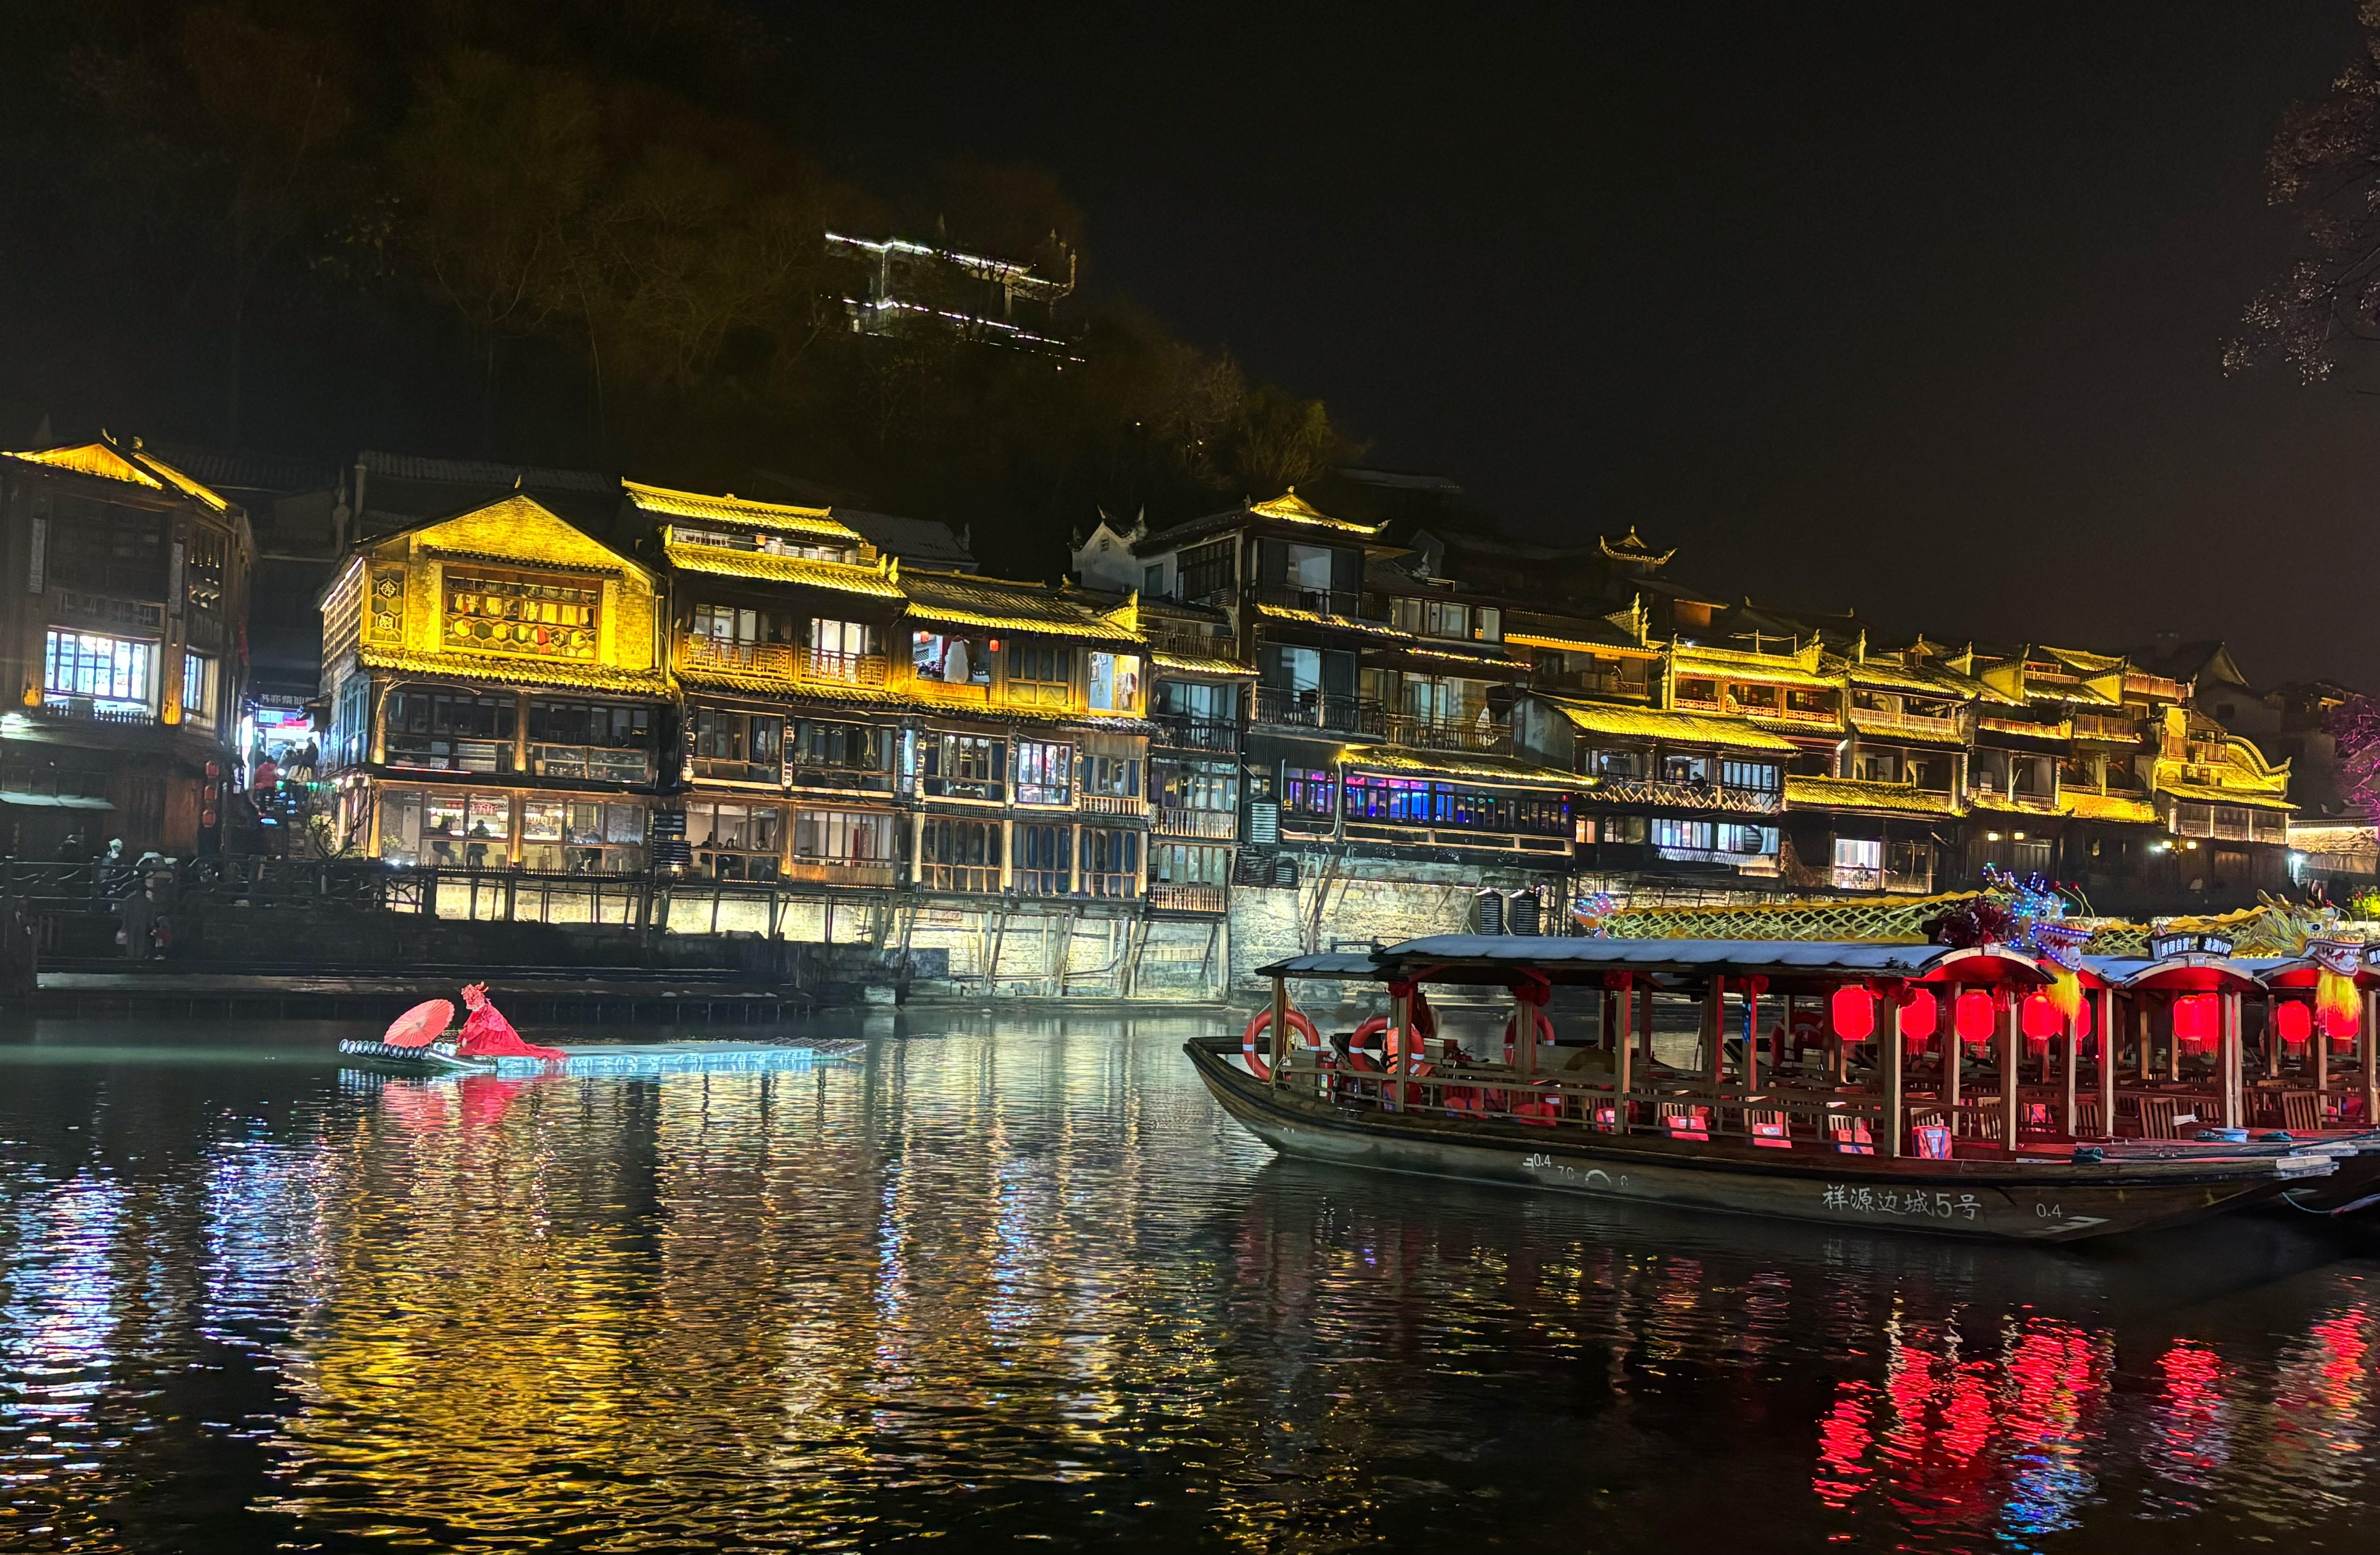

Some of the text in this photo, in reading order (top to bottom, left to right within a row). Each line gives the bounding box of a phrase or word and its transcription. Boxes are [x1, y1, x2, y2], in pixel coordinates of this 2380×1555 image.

[1534, 1153, 1552, 1167] 0.4
[1822, 1184, 1981, 1220] 祥源边城5号
[2036, 1203, 2062, 1218] 0.4
